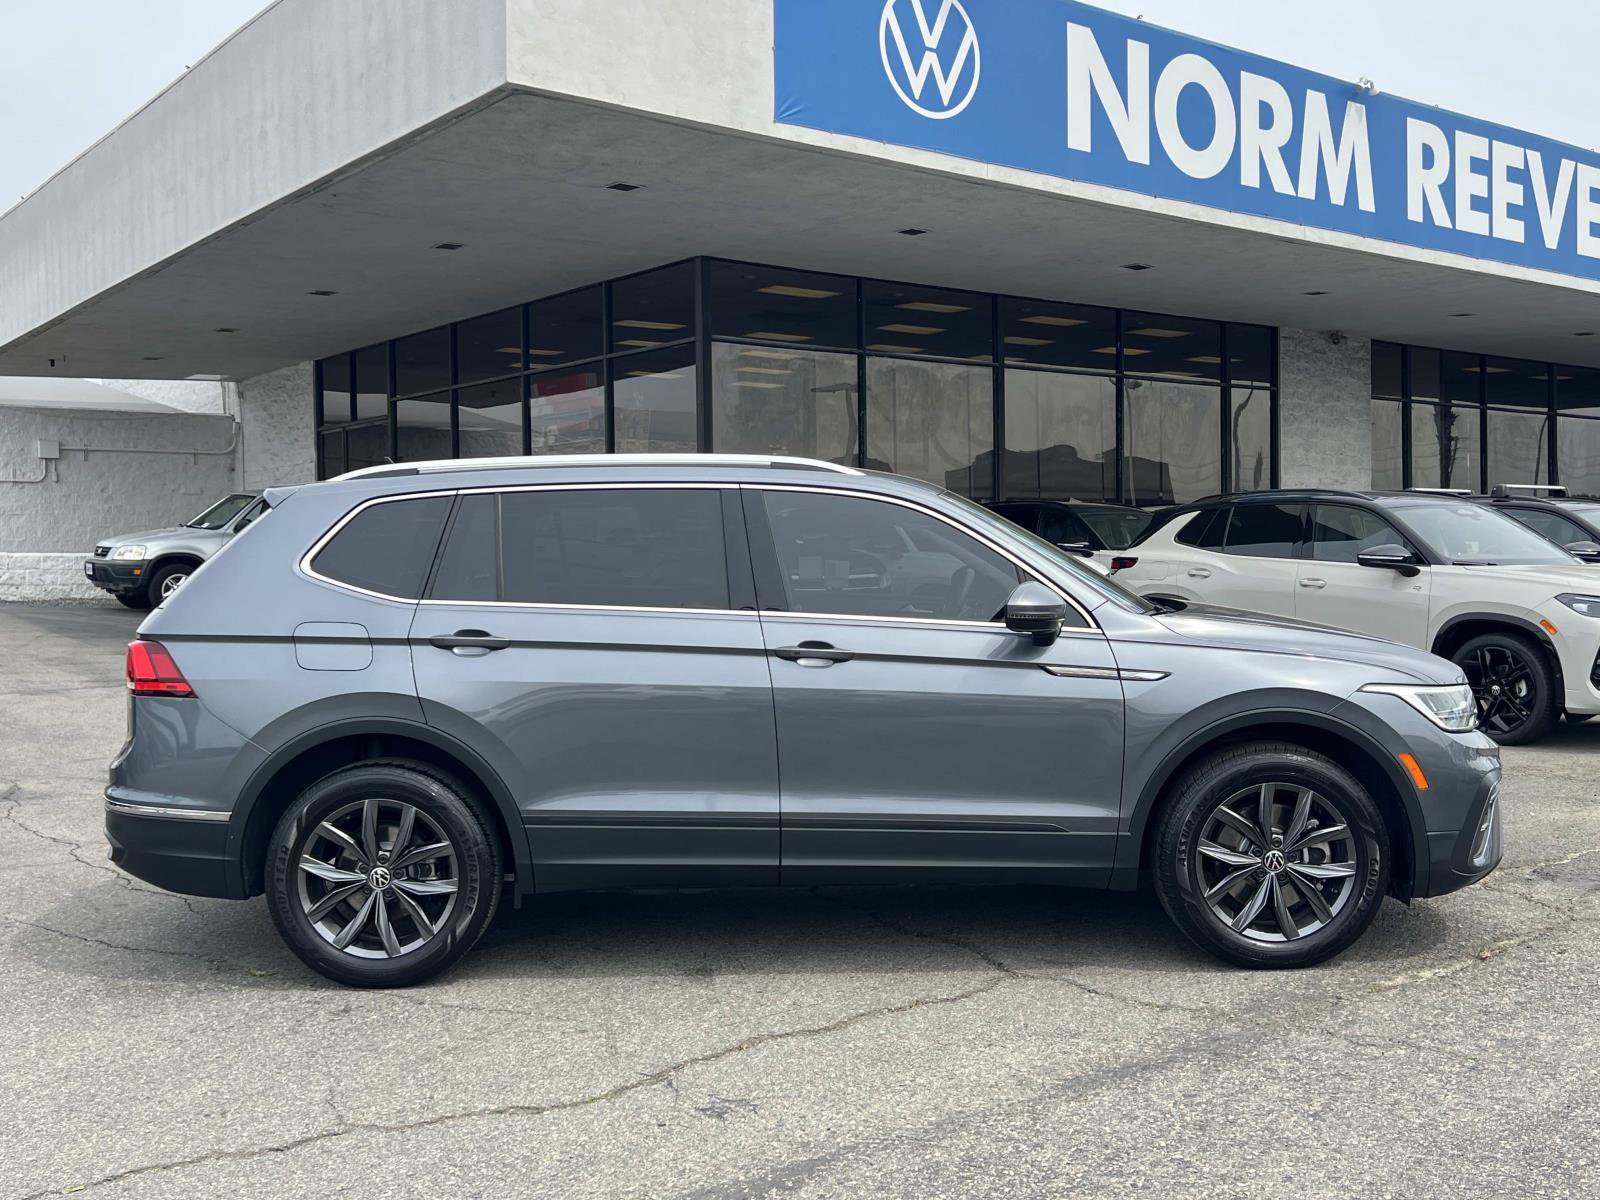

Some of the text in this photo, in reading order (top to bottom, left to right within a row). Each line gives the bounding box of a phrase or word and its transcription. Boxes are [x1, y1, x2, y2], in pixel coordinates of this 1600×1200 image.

[886, 0, 975, 107] VW
[1066, 21, 1600, 260] NORM REEVE
